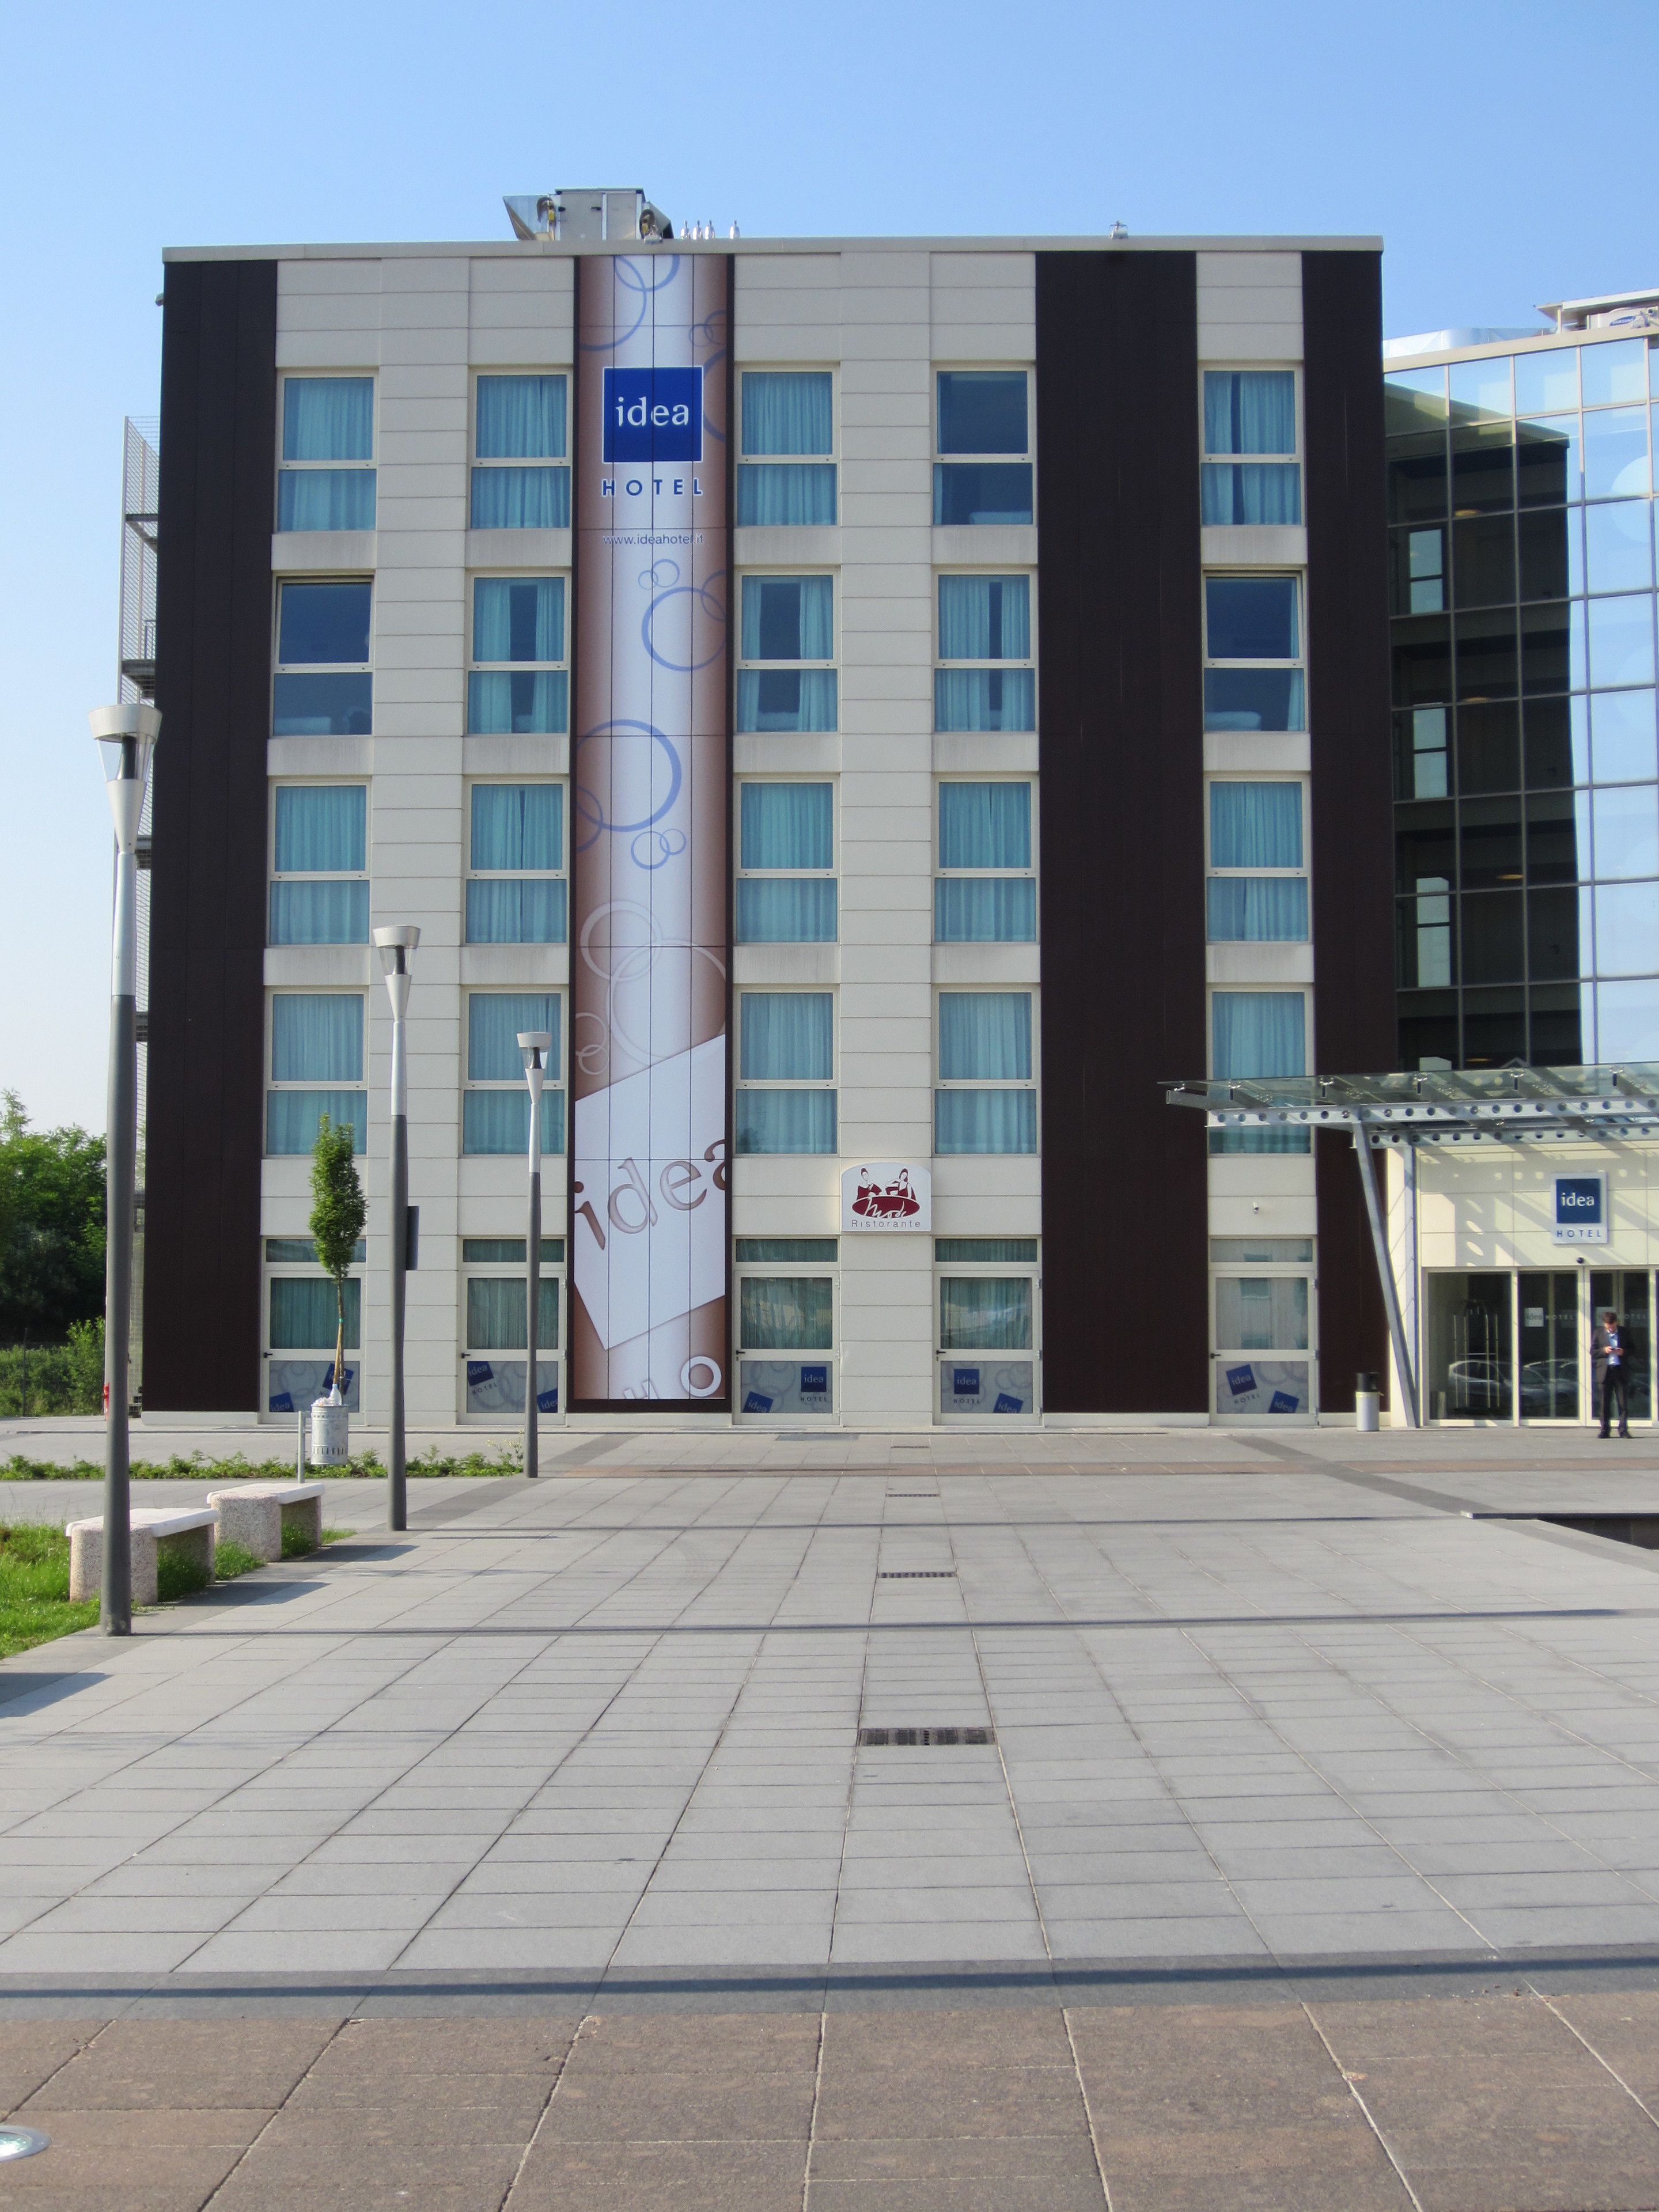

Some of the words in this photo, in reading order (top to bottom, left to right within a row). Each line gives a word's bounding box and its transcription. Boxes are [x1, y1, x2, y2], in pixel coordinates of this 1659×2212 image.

[615, 396, 689, 426] idea
[602, 479, 702, 496] HOTEL
[603, 534, 703, 544] www.ideahotel.it
[1561, 1192, 1594, 1206] idea
[851, 1219, 921, 1228] Ristorante
[1556, 1229, 1601, 1237] HOTEL
[468, 1364, 488, 1377] idea
[804, 1374, 824, 1383] idea
[957, 1376, 977, 1385] idea
[1232, 1374, 1251, 1385] idea
[472, 1382, 498, 1395] HOTEL
[1234, 1393, 1260, 1404] HOTEL
[270, 1402, 290, 1412] idea
[748, 1399, 767, 1412] idea
[998, 1401, 1018, 1413] idea
[1274, 1399, 1294, 1412] idea
